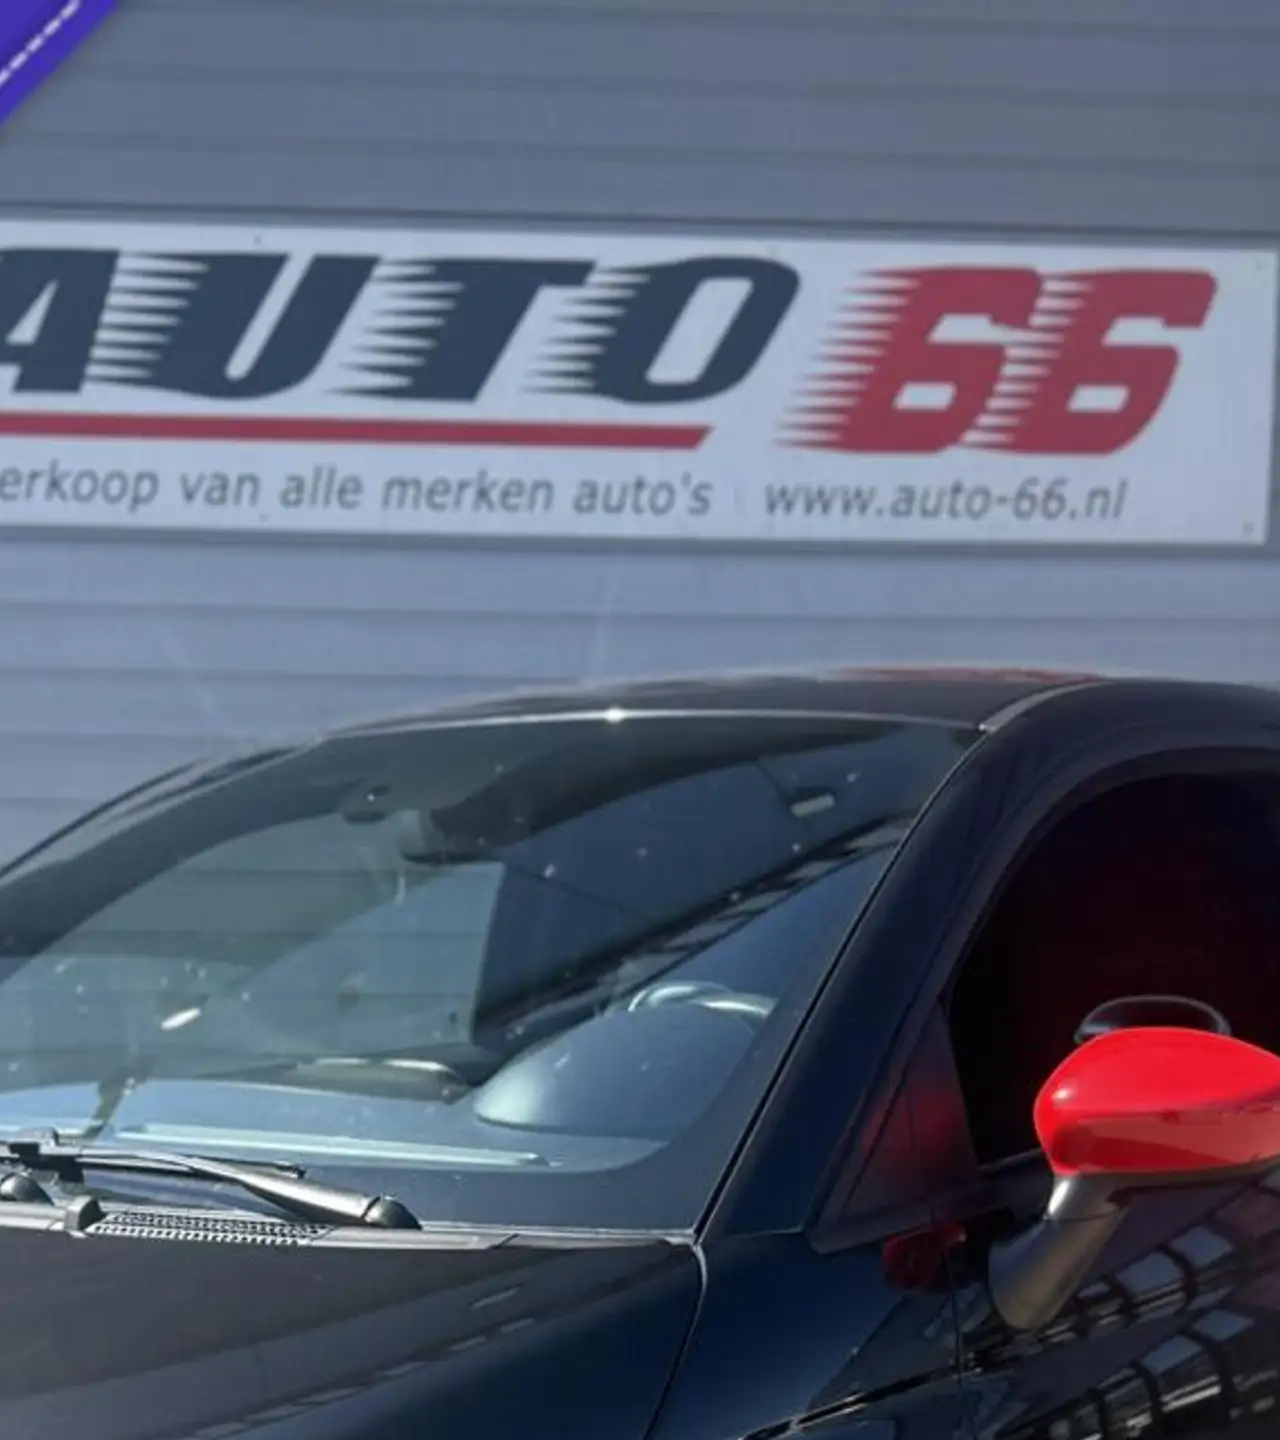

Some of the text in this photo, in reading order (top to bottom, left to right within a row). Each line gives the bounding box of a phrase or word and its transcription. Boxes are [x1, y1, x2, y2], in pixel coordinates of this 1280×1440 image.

[775, 265, 1218, 457] 66
[179, 472, 261, 506] van
[279, 467, 364, 509] alle
[382, 471, 554, 512] merken
[572, 472, 713, 516] auto's
[765, 478, 1129, 520] www.auto-66.nl
